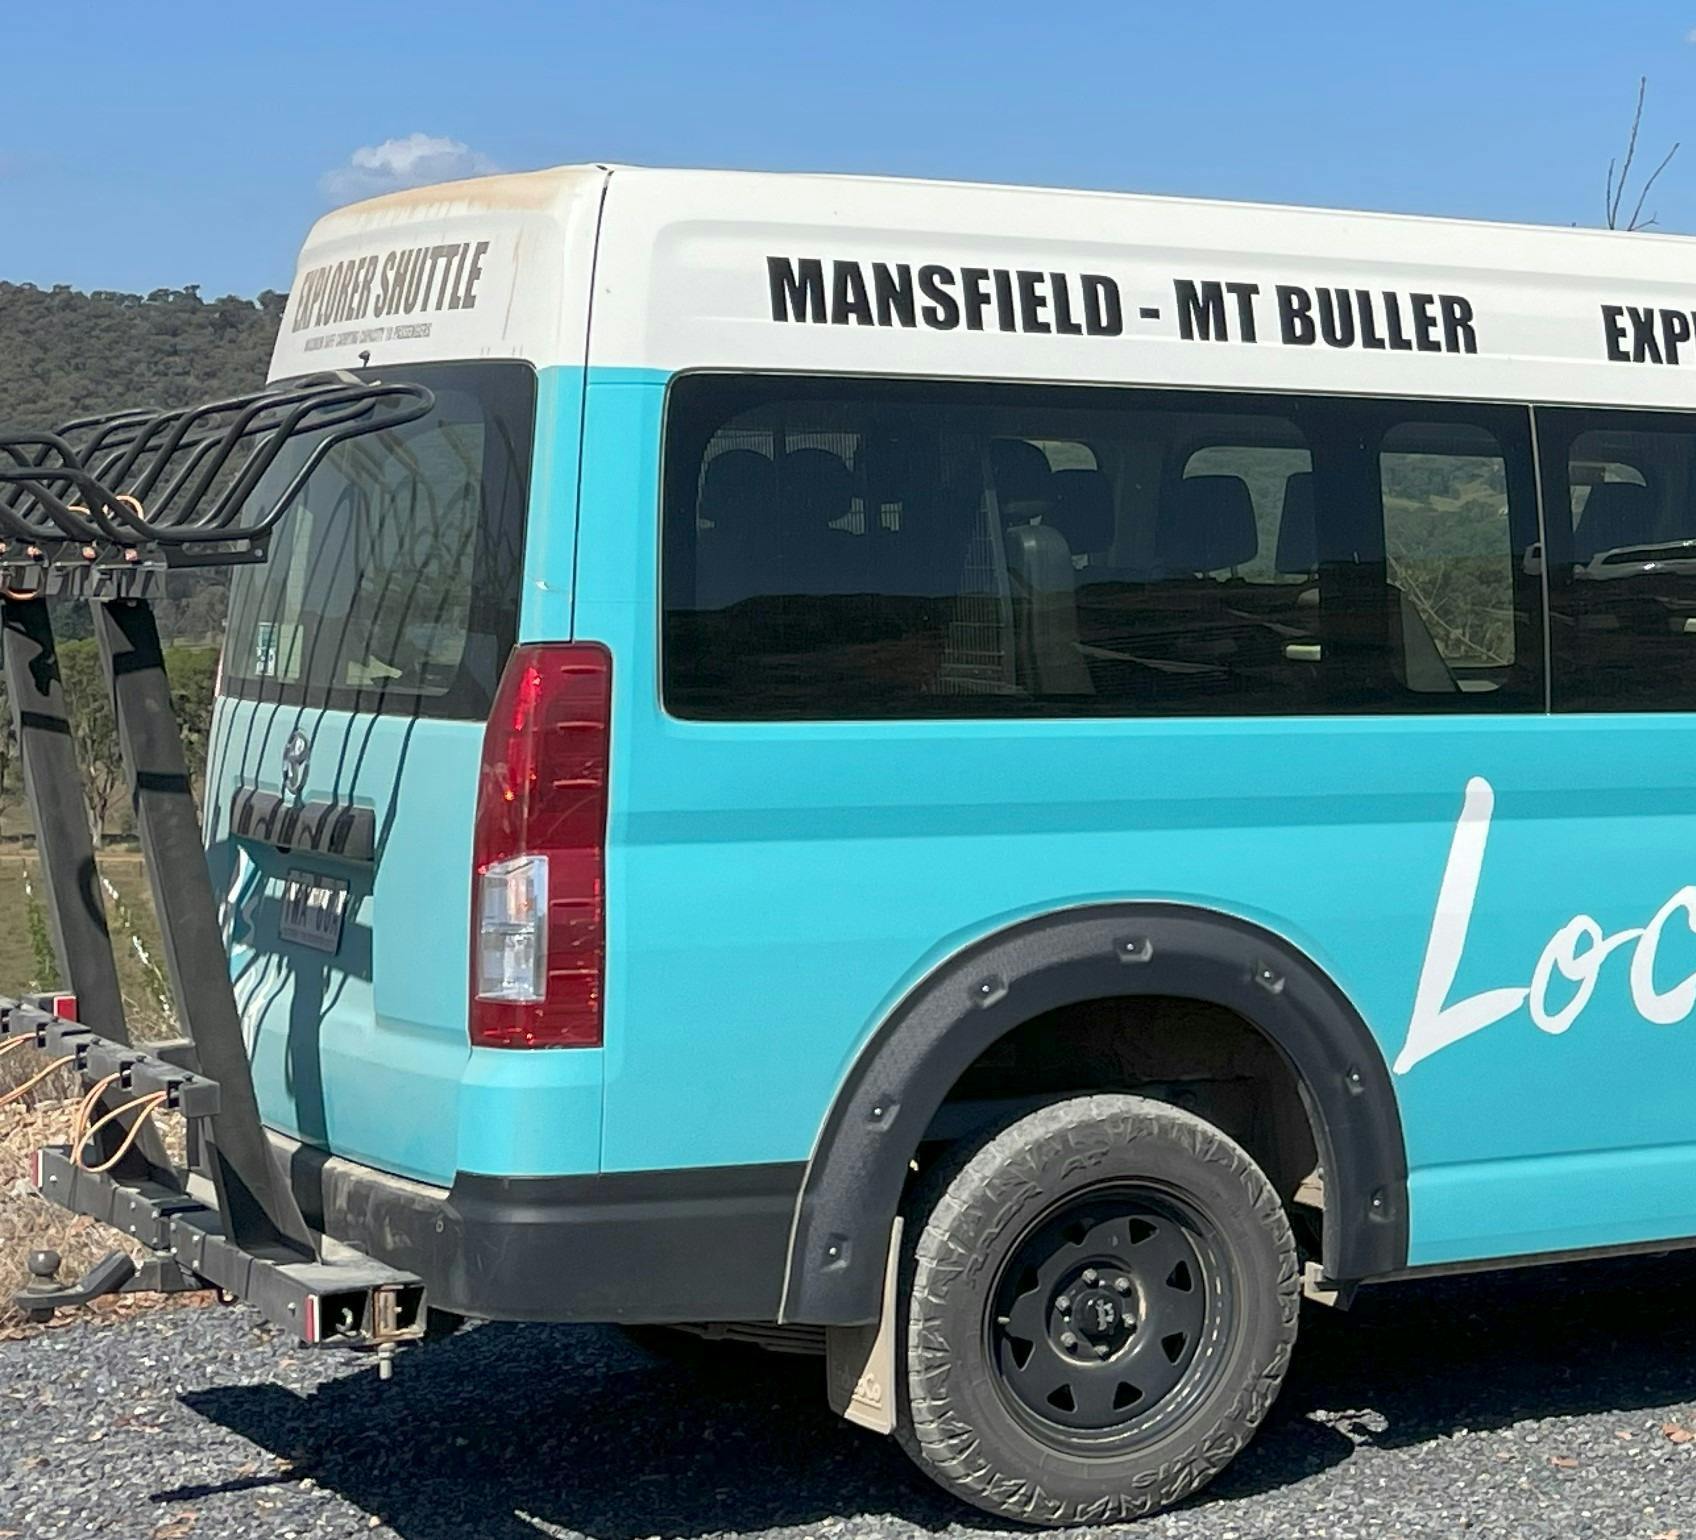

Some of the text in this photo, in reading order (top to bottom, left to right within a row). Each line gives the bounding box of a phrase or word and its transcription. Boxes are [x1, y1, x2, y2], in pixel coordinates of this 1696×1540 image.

[291, 241, 490, 334] EXPLORER SHUTTLE
[766, 256, 1479, 354] MANSFIELD - MT BULLER
